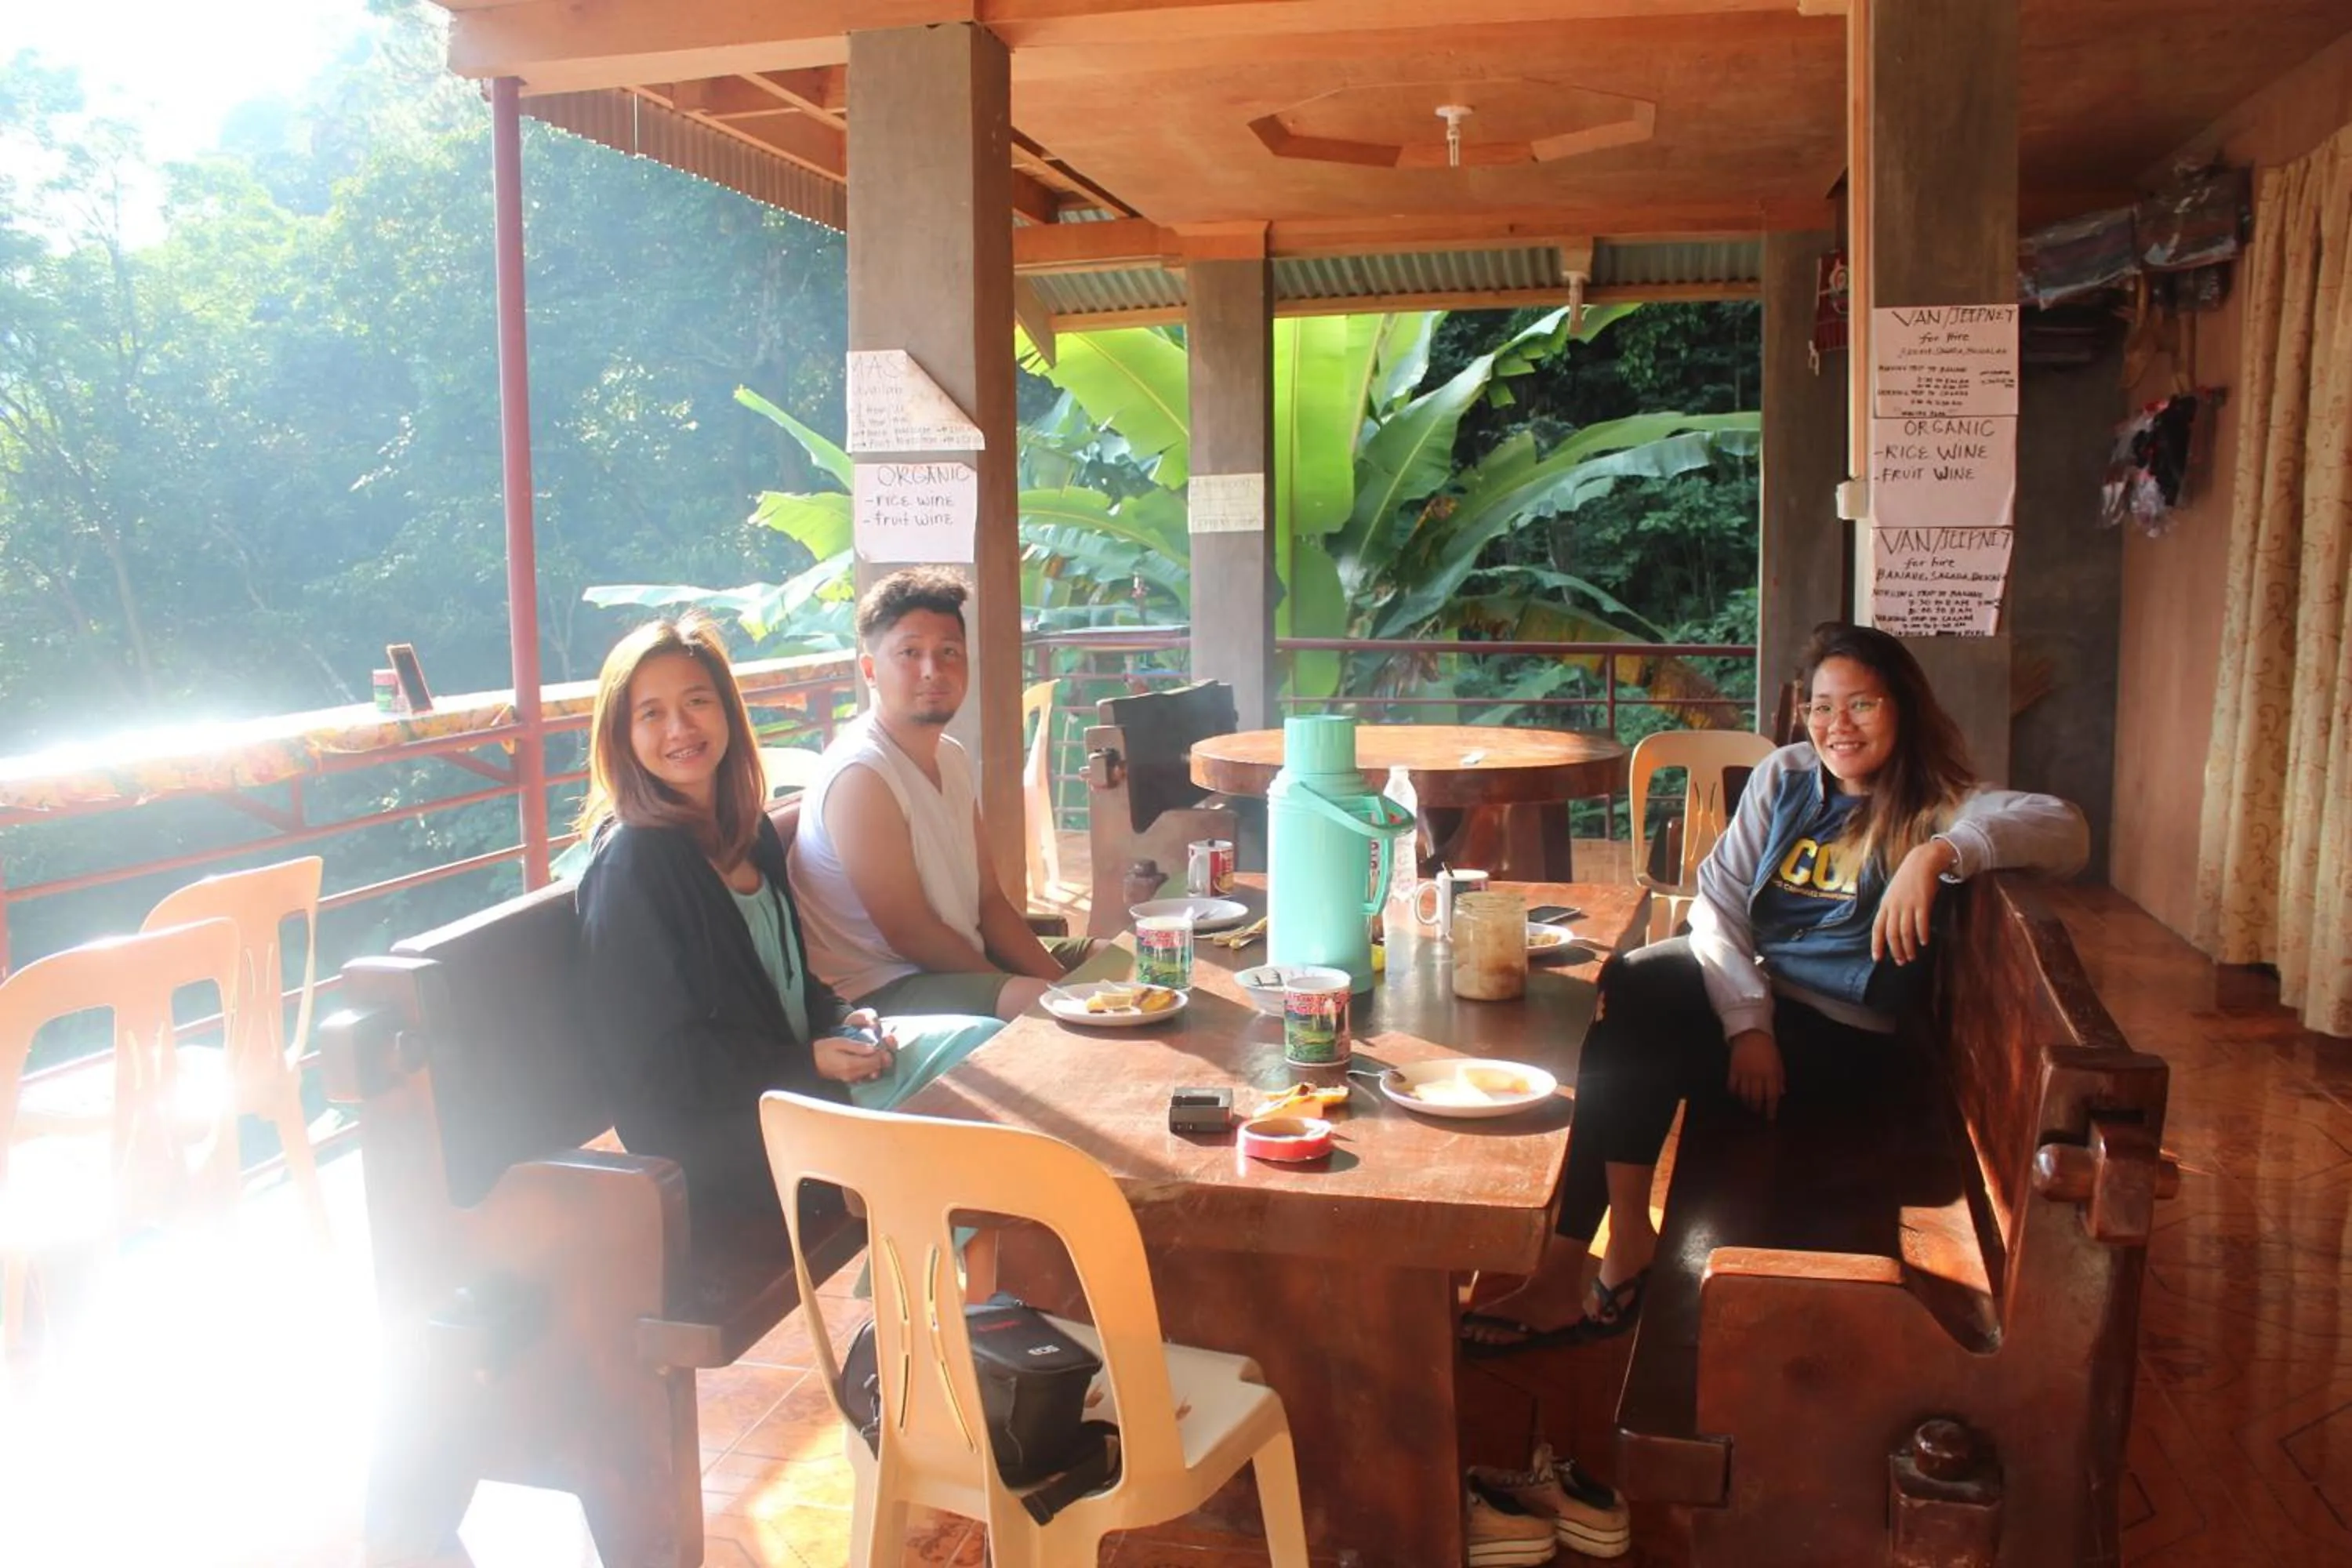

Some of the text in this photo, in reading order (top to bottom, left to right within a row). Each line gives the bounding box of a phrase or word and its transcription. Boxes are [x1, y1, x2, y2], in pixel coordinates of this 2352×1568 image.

[1920, 332, 1939, 343] for
[1904, 419, 1995, 437] ORGANIC
[1937, 443, 1988, 460] WINE
[877, 465, 970, 486] ORGANIC
[1933, 466, 1976, 481] WINE
[1905, 557, 1956, 569] for hire
